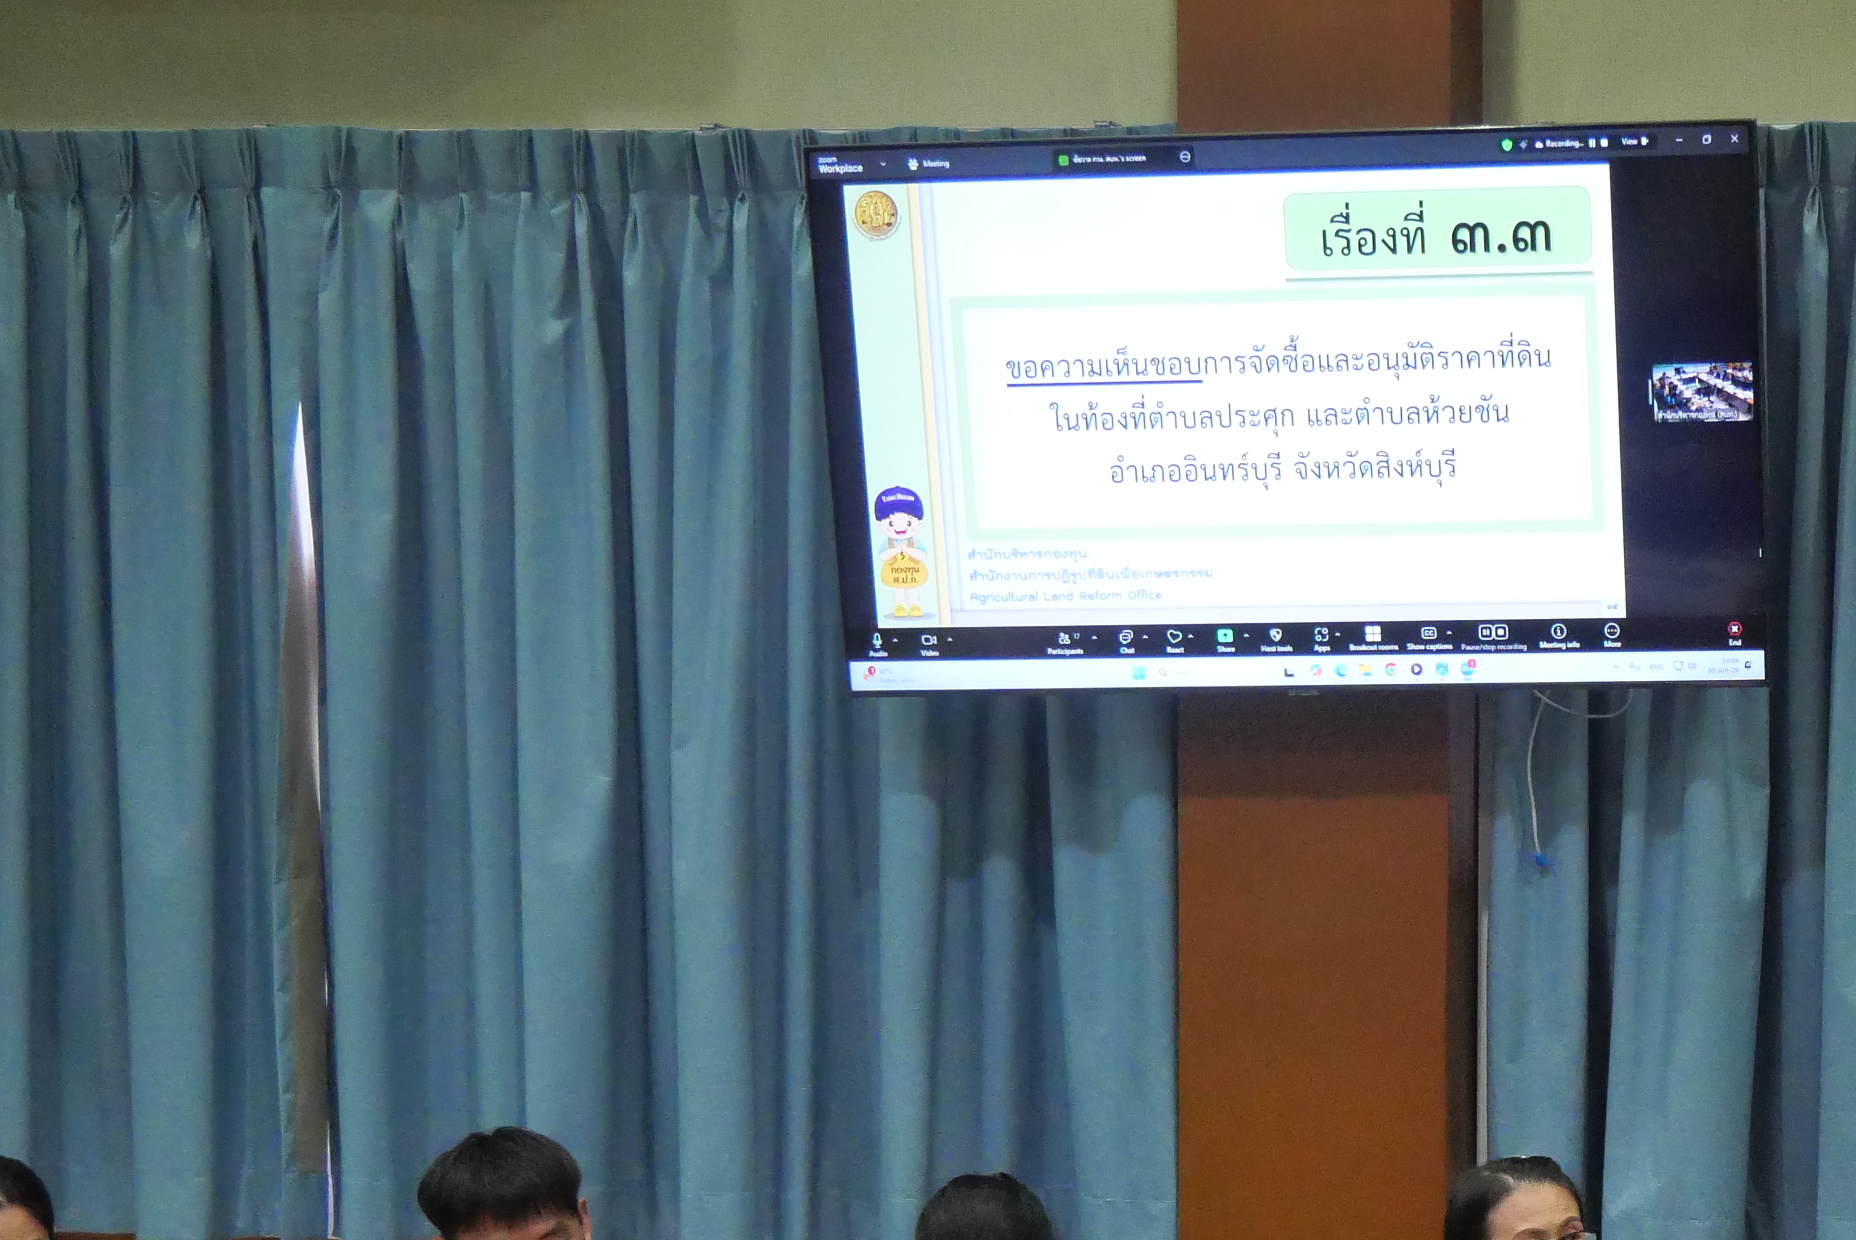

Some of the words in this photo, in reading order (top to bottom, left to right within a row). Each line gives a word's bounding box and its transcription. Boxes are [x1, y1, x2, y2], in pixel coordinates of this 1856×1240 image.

[1622, 137, 1638, 145] View
[819, 164, 863, 174] Workplace
[923, 160, 950, 168] Meeting
[1322, 201, 1426, 257] เรื่องที่
[1451, 219, 1552, 255] ๓.๓
[1006, 332, 1552, 381] ขอความเห็นชอบการจัดซื้อและอนุมัติราคาที่ดิน
[1049, 394, 1294, 438] ในท้องที่ตำบลประศุก
[1307, 393, 1510, 427] และตำบลห้วยชัน
[1110, 451, 1282, 491] อำเภออินทร์บุรี
[1294, 448, 1456, 488] จังหวัดสิงห์บุรี
[967, 547, 1087, 563] สำนักบริหารกองทุน
[891, 566, 920, 576] กองทุน
[969, 564, 1213, 585] สำนักงานการปฏิรูปที่ดินเพื่อเกษตรกรรม
[971, 591, 1038, 605] Agricultural
[1044, 591, 1073, 601] Land
[1079, 591, 1122, 601] Reform
[1128, 589, 1163, 600] Office
[1314, 645, 1331, 653] Apps
[1349, 643, 1377, 651] Breakout
[1427, 643, 1453, 651] captions
[1461, 643, 1496, 652] Pause/stop
[1497, 643, 1527, 652] recording
[1540, 641, 1566, 650] Meeting
[1567, 640, 1580, 648] info
[1604, 640, 1621, 648] More
[1047, 648, 1084, 656] Participants
